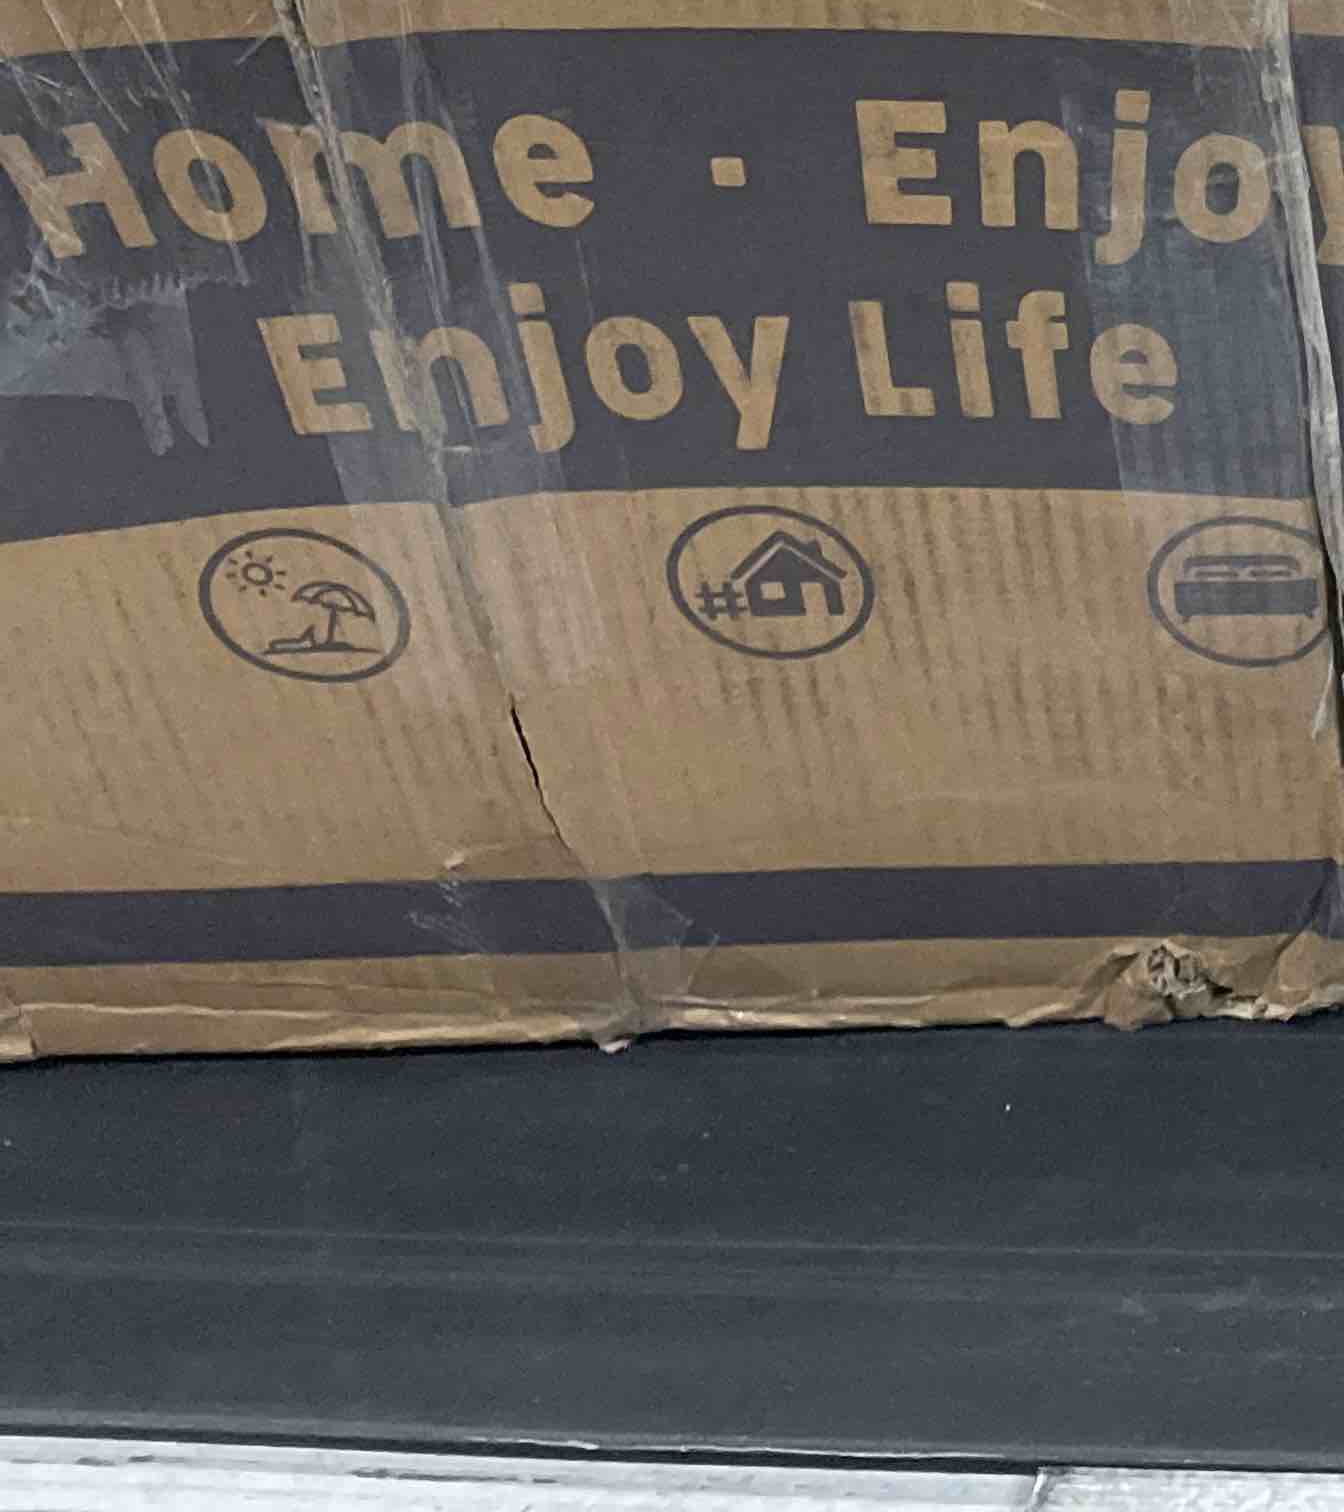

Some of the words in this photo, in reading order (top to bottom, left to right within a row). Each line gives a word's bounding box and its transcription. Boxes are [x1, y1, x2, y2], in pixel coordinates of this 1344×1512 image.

[0, 114, 595, 260] Home
[256, 281, 797, 453] Enjoy
[847, 280, 1178, 425] Life
